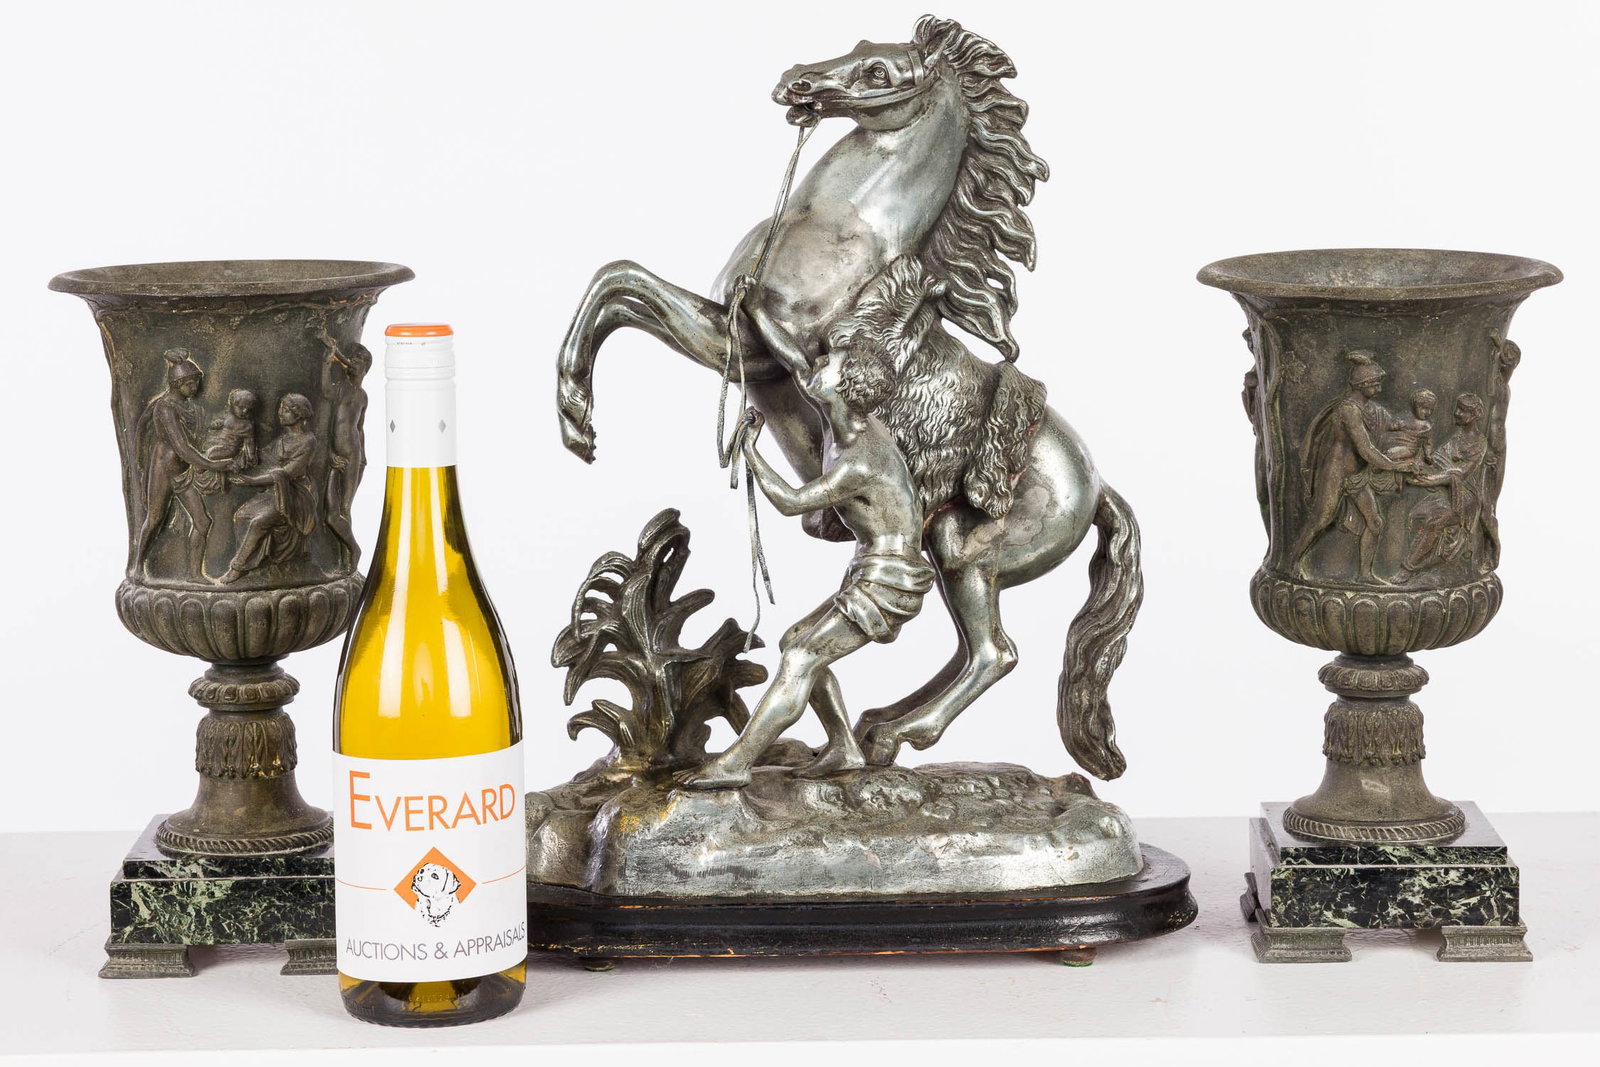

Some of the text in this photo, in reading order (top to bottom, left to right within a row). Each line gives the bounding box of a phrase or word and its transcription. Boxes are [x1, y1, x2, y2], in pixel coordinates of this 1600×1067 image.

[349, 770, 515, 831] EVERARD
[346, 921, 526, 960] AUCTIONS & APPRAISALS
